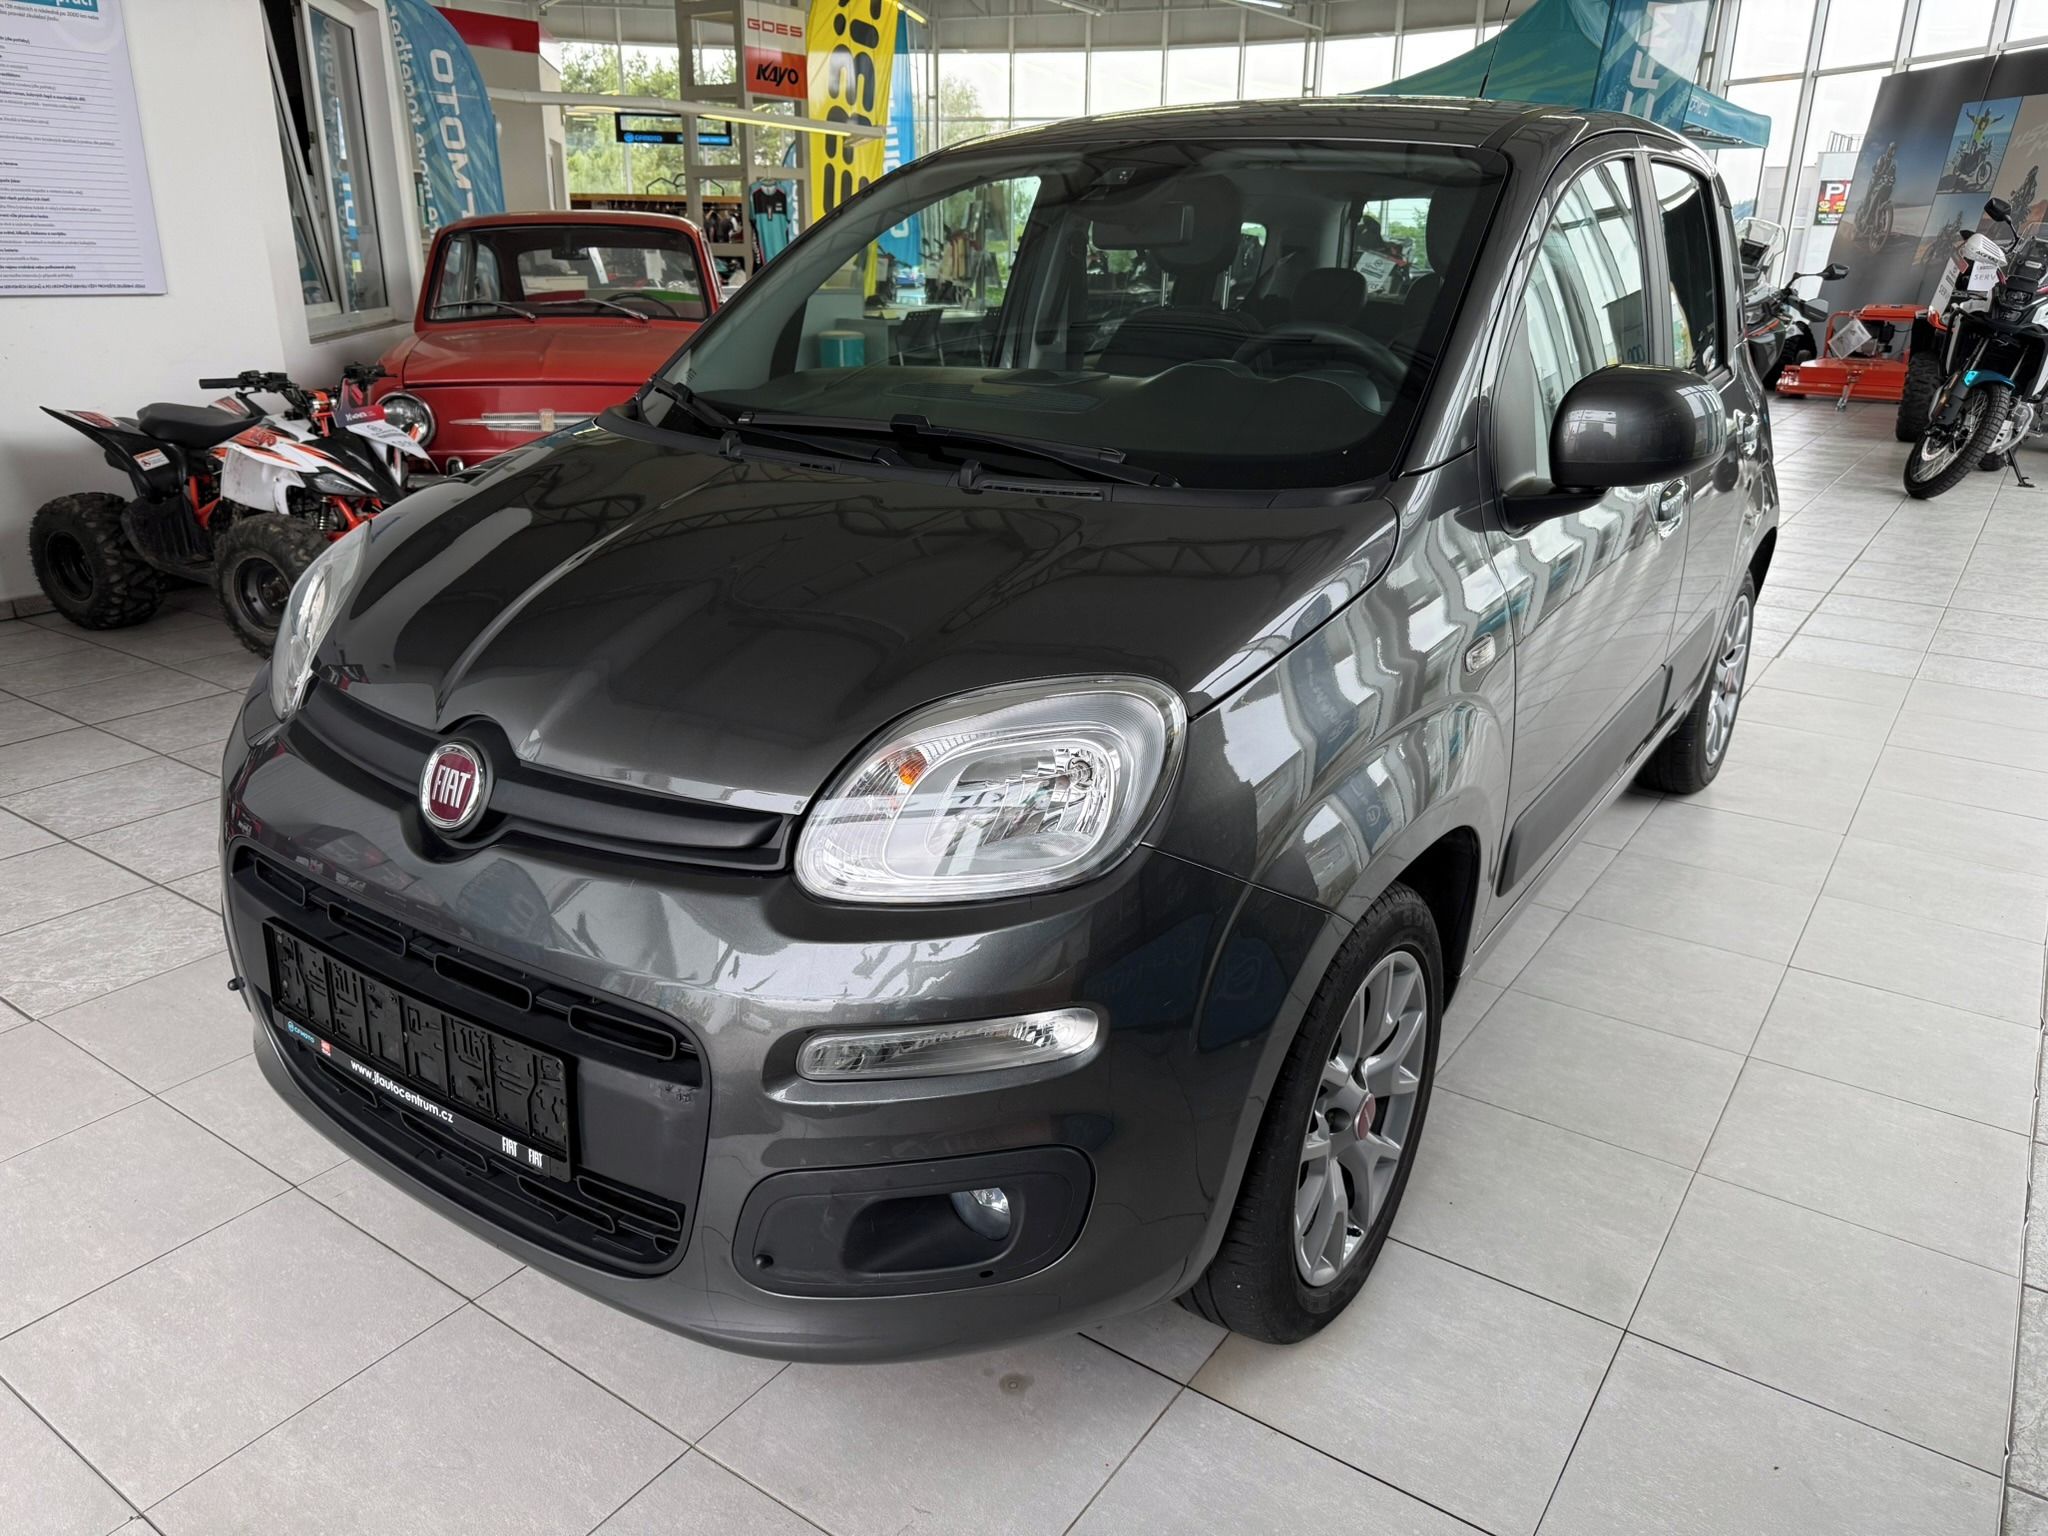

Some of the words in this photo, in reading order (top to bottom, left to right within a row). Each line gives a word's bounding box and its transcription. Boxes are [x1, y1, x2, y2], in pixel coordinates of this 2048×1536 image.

[747, 17, 803, 38] GOES
[431, 763, 472, 809] FIAT
[350, 1059, 454, 1123] www.jfautocentrum.cz
[502, 1135, 518, 1158] FIAT
[528, 1148, 544, 1169] FIAT
